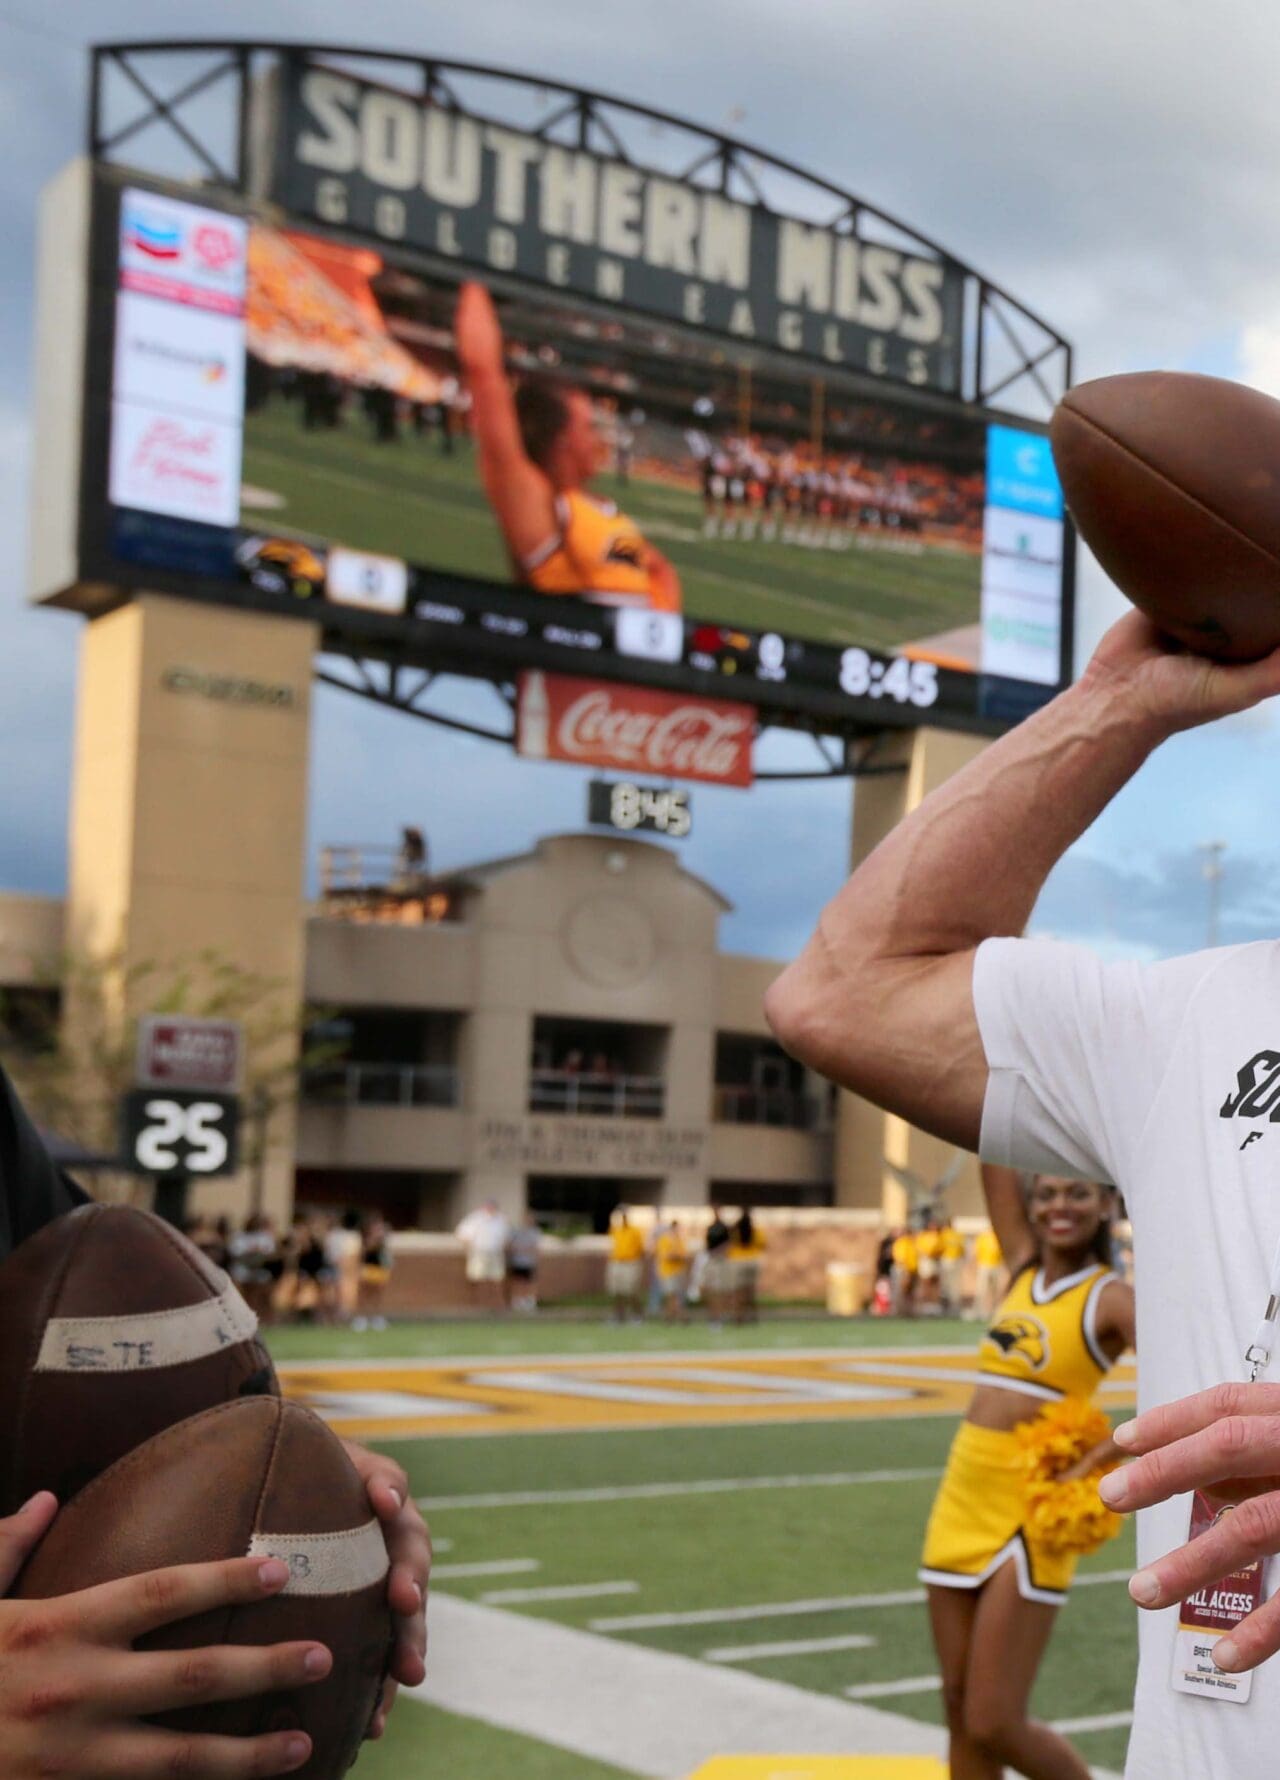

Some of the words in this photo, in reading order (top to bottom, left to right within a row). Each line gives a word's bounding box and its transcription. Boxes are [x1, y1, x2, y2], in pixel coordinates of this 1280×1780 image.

[297, 70, 750, 289] SOUTHERN
[777, 220, 945, 343] MISS
[315, 177, 624, 299] GOLDEN
[684, 283, 929, 386] EAGLES
[839, 648, 938, 707] 8:45
[136, 1099, 228, 1172] 25
[1185, 1588, 1208, 1607] ALL
[1207, 1589, 1254, 1613] ACCESS
